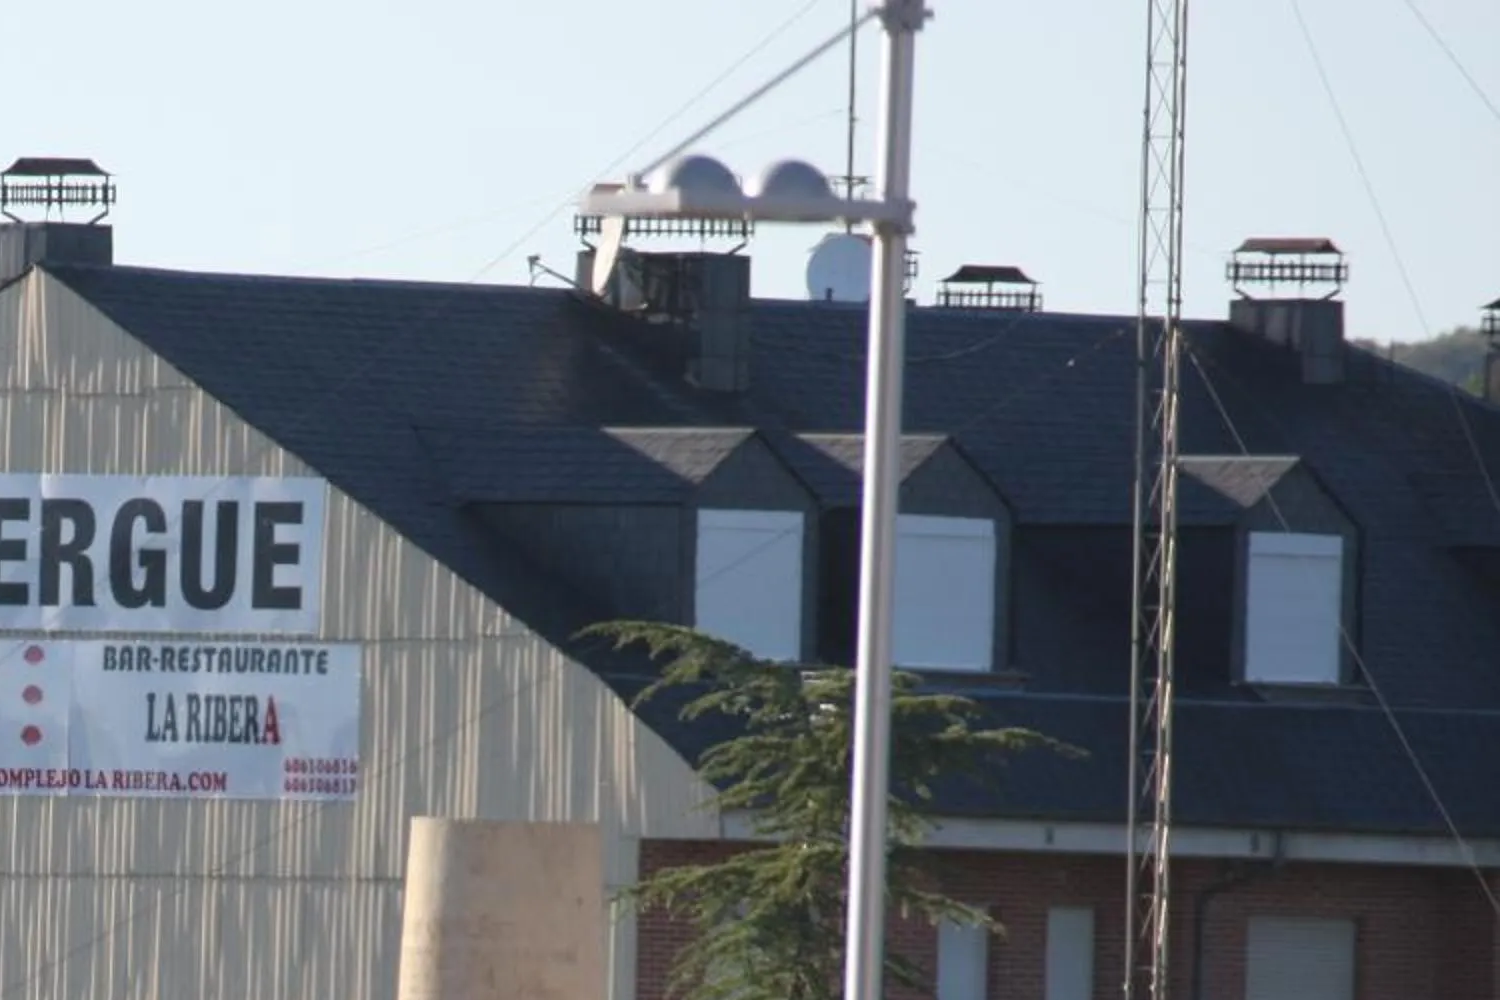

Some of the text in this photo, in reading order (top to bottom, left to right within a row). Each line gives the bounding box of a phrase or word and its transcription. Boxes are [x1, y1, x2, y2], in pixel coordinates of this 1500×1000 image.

[102, 645, 330, 675] BAR-RESTAURANTE
[145, 691, 281, 745] LA RIBERA
